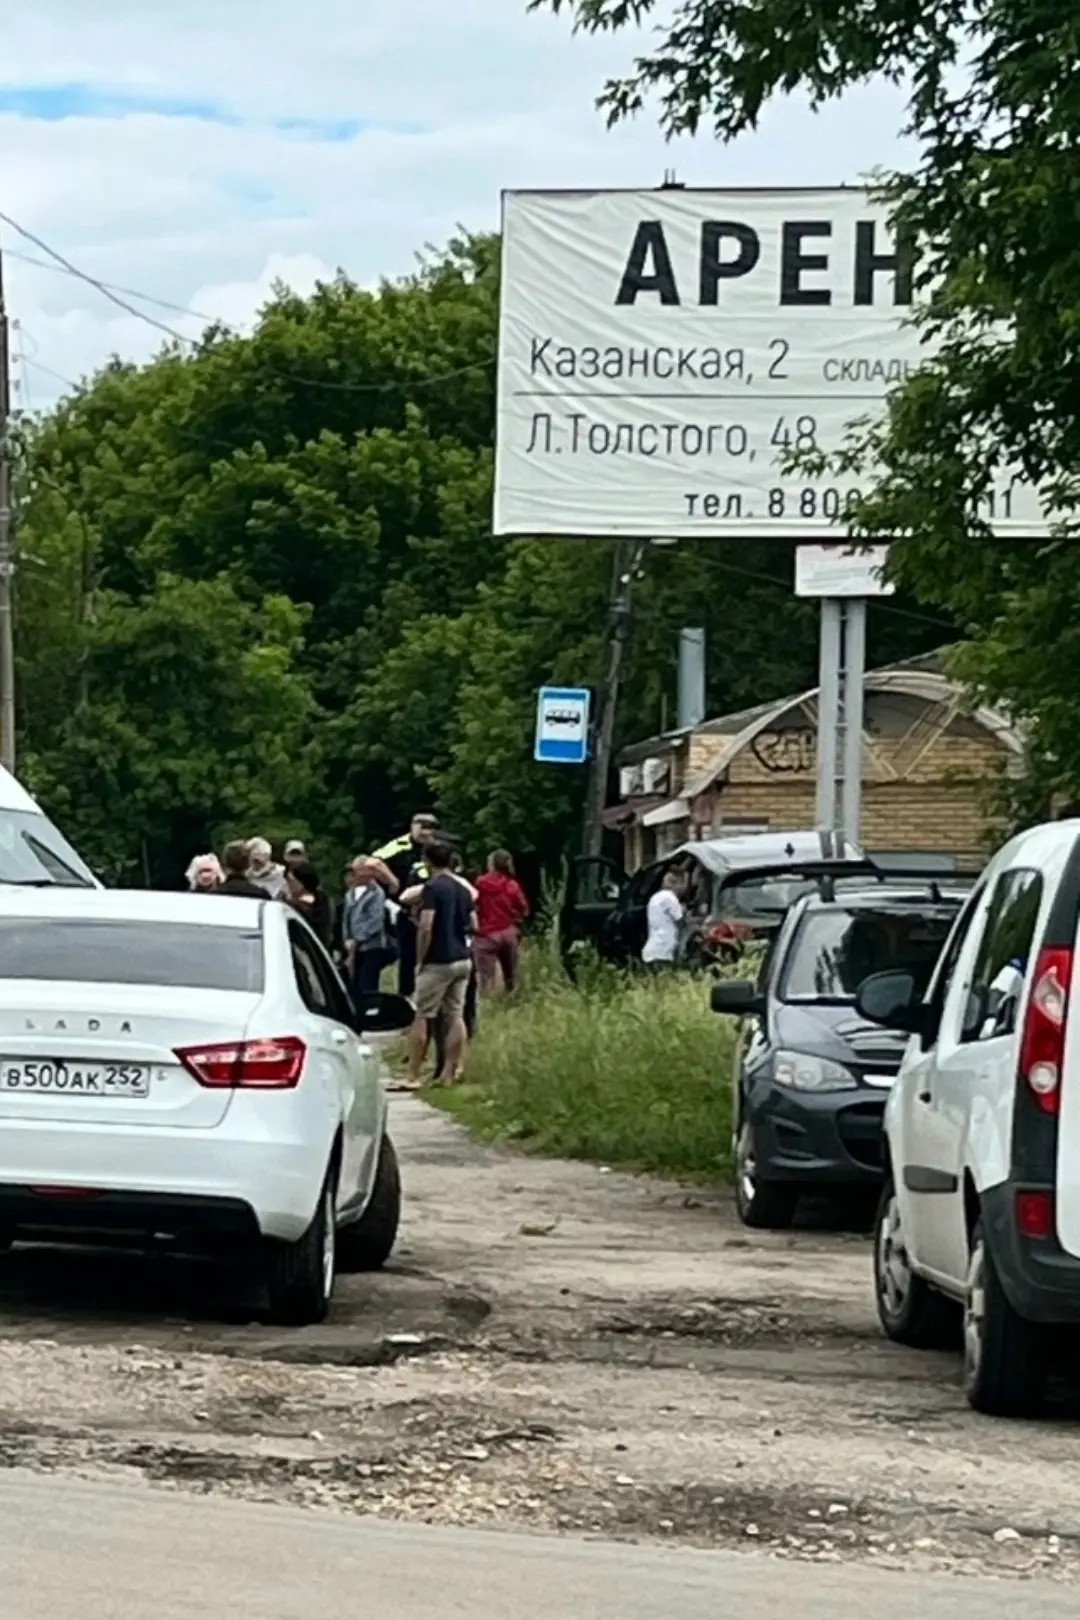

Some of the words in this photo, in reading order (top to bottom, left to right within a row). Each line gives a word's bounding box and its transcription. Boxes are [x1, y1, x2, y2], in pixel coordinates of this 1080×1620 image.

[530, 337, 753, 385] Казанская,
[768, 338, 789, 379] 2
[526, 413, 756, 462] Л.Толстого,
[770, 415, 817, 452] 48
[684, 493, 753, 518] тел.
[768, 487, 784, 518] 8
[26, 1019, 132, 1033] LADA
[105, 1067, 143, 1087] 252
